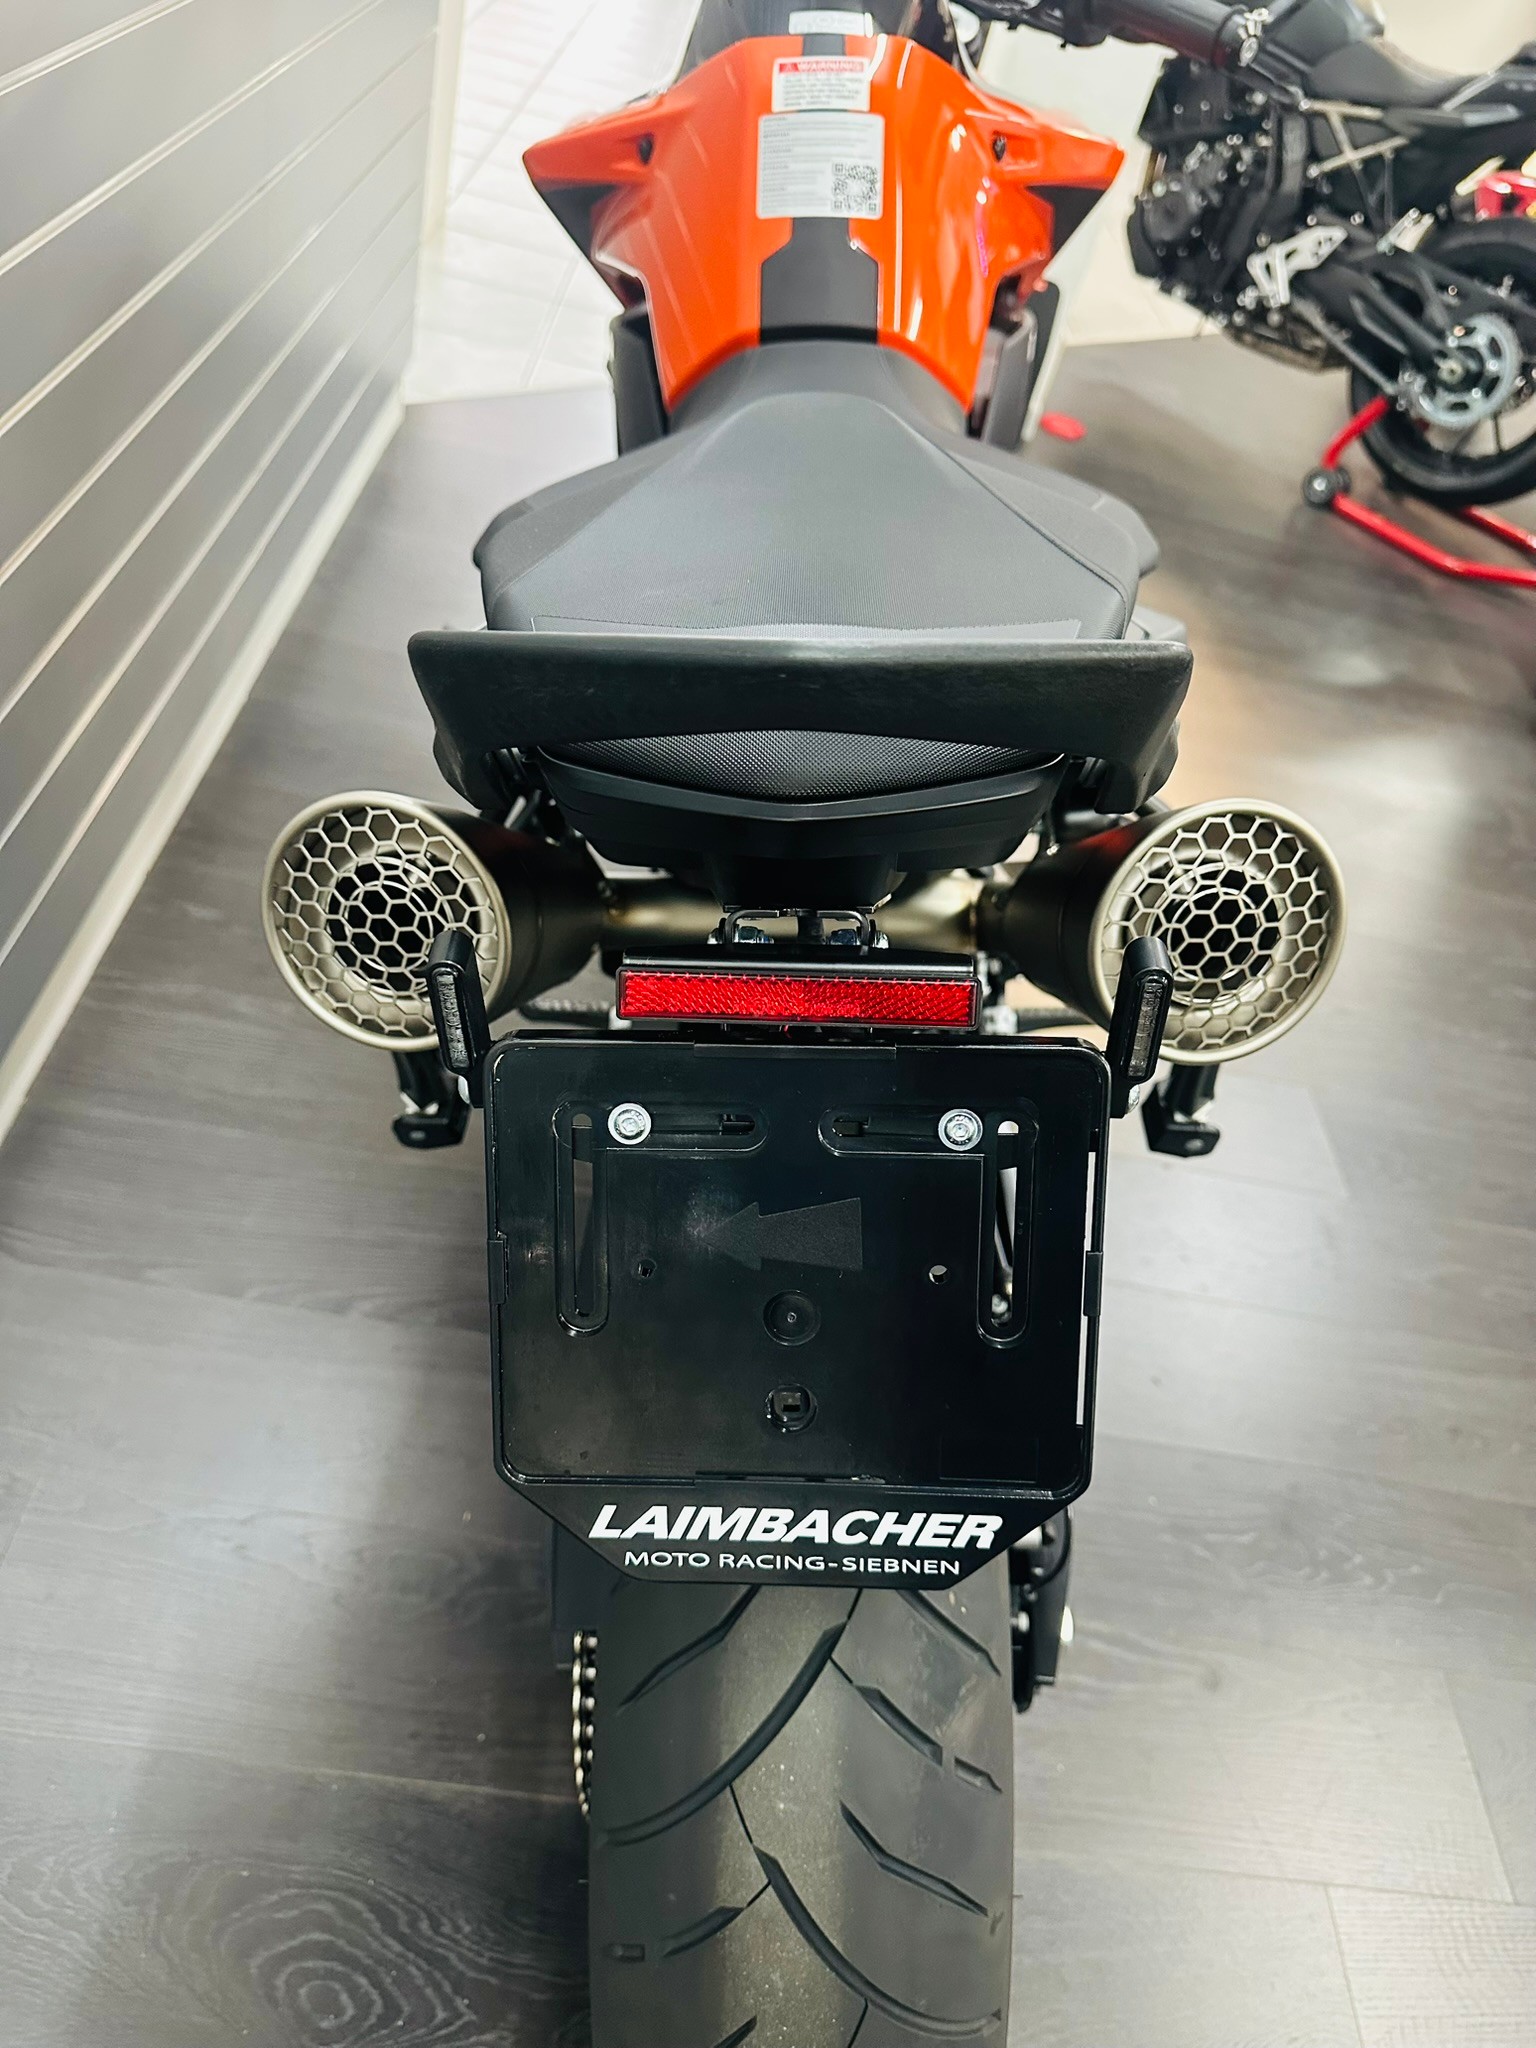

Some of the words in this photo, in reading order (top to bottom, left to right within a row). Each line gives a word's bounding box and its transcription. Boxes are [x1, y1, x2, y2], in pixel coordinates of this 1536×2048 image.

[588, 1504, 1003, 1548] LAIMBACHER
[624, 1551, 710, 1567] MOTO
[718, 1553, 960, 1575] RACING-SIEBNEN
